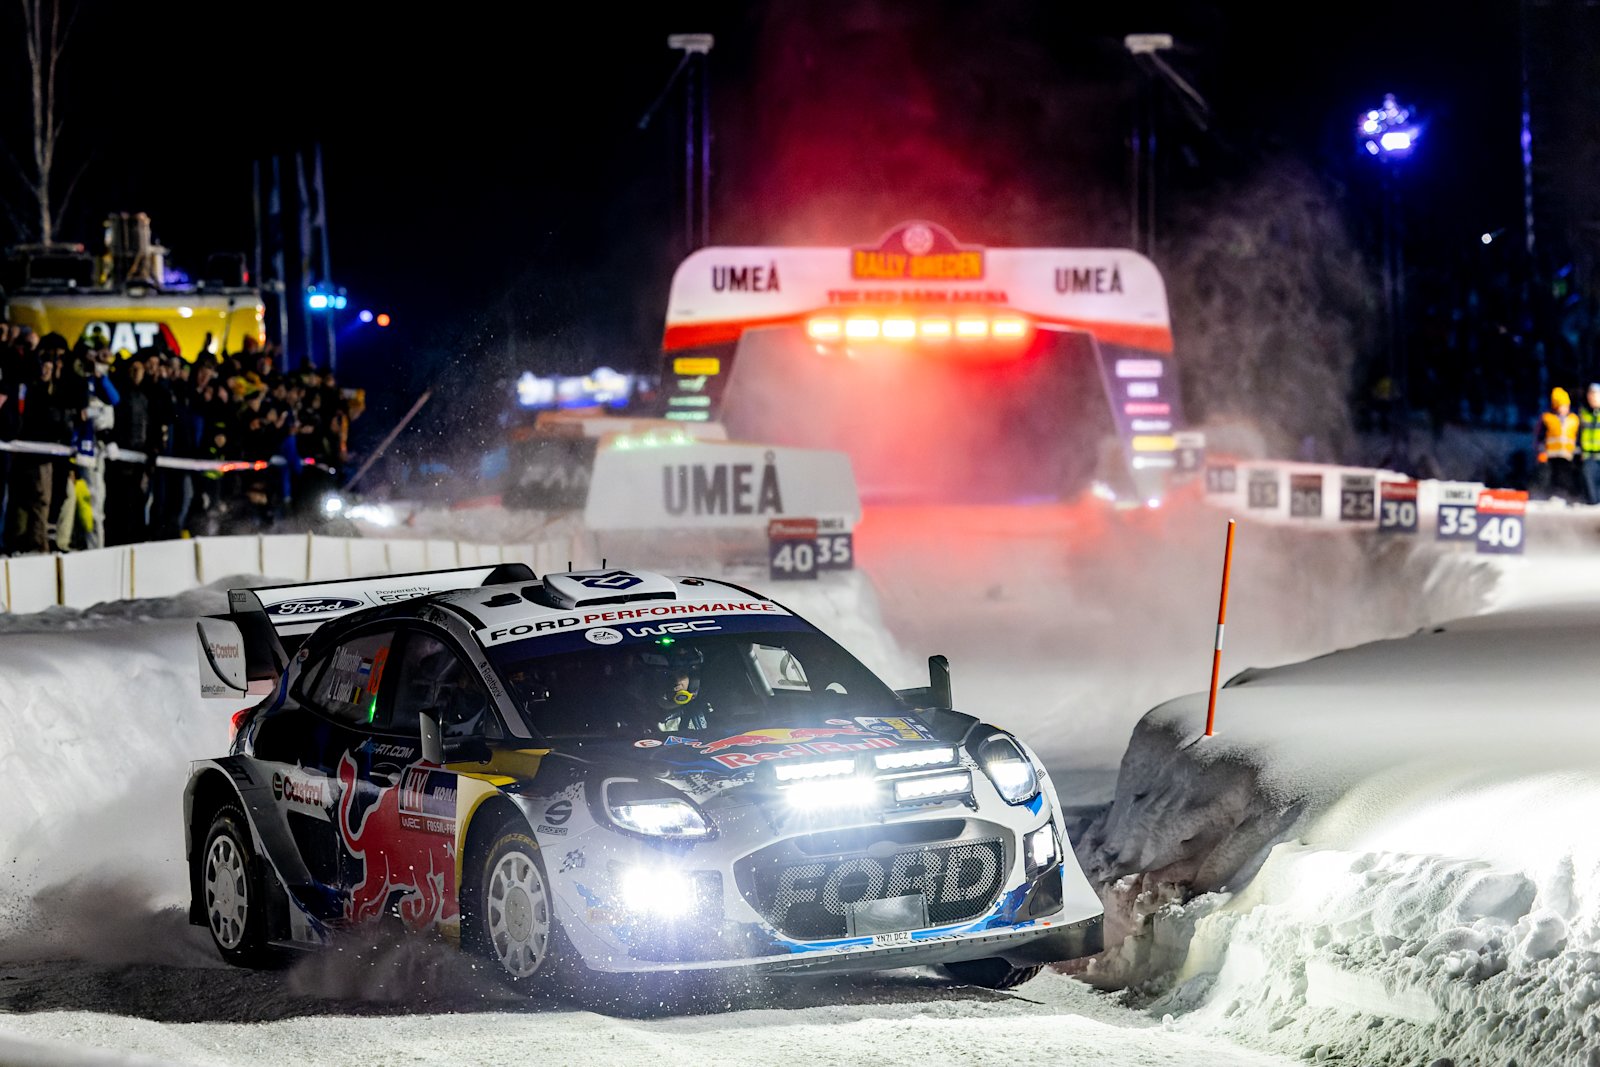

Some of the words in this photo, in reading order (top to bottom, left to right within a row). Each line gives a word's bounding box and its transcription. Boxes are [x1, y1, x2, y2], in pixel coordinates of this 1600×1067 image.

[712, 260, 780, 293] UMEÅ
[1054, 264, 1124, 294] UMEÅ
[664, 450, 784, 515] UMEÅ
[1343, 492, 1373, 517] 25
[1382, 501, 1415, 527] 30
[1440, 507, 1477, 535] 35
[1478, 517, 1521, 547] 40
[773, 544, 814, 572] 40
[816, 537, 850, 564] 35
[376, 587, 417, 596] Powered
[278, 600, 345, 615] Ford
[490, 616, 581, 642] FORD
[583, 601, 777, 624] PERFORMANCE
[626, 619, 722, 638] WRC
[215, 643, 240, 659] Castrol
[711, 744, 814, 769] Red
[811, 737, 900, 756] Bull
[283, 776, 323, 807] Castrol
[402, 816, 421, 829] WRC
[537, 824, 568, 836] sparco
[769, 844, 997, 924] FORD
